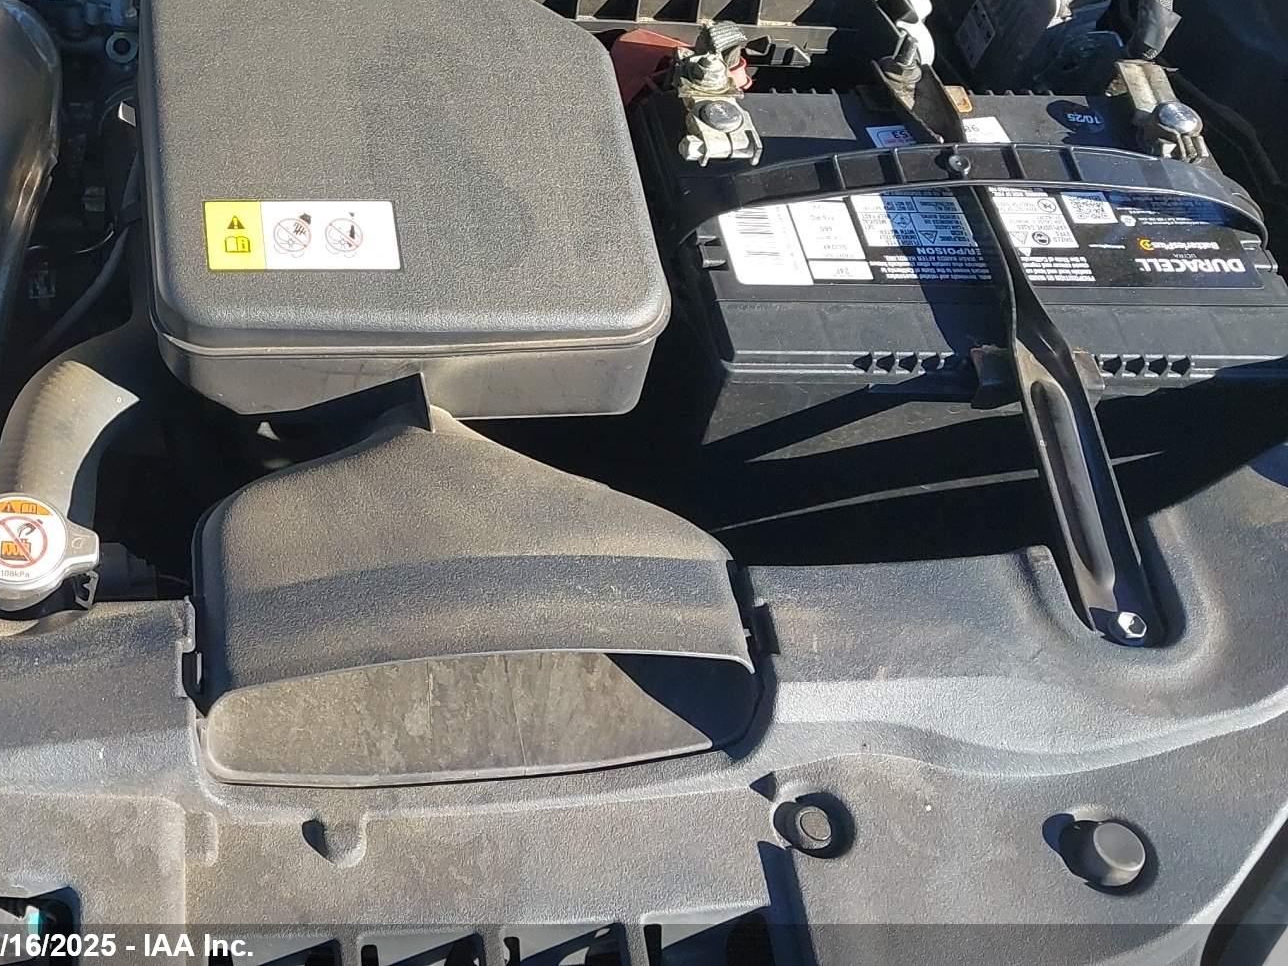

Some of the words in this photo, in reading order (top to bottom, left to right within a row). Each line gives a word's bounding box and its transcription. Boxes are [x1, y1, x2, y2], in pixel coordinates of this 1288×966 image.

[1067, 113, 1101, 124] 10/25
[1135, 258, 1246, 272] DURACELL
[0, 569, 30, 578] 108kPa
